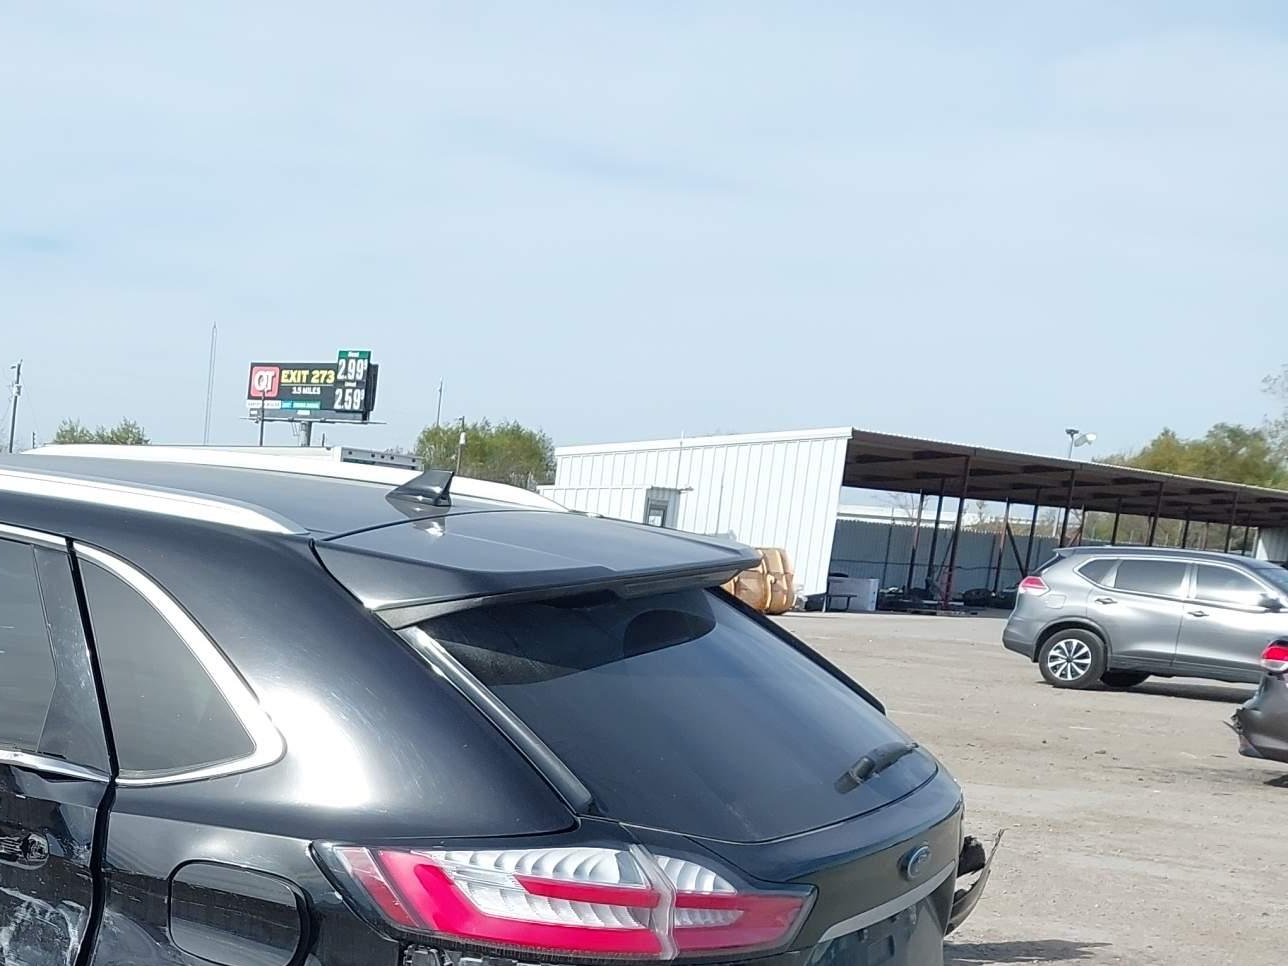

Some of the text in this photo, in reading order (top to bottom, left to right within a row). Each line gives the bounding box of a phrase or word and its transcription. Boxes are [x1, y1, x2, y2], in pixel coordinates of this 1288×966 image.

[254, 370, 275, 392] QT
[280, 369, 335, 383] EXIT 273
